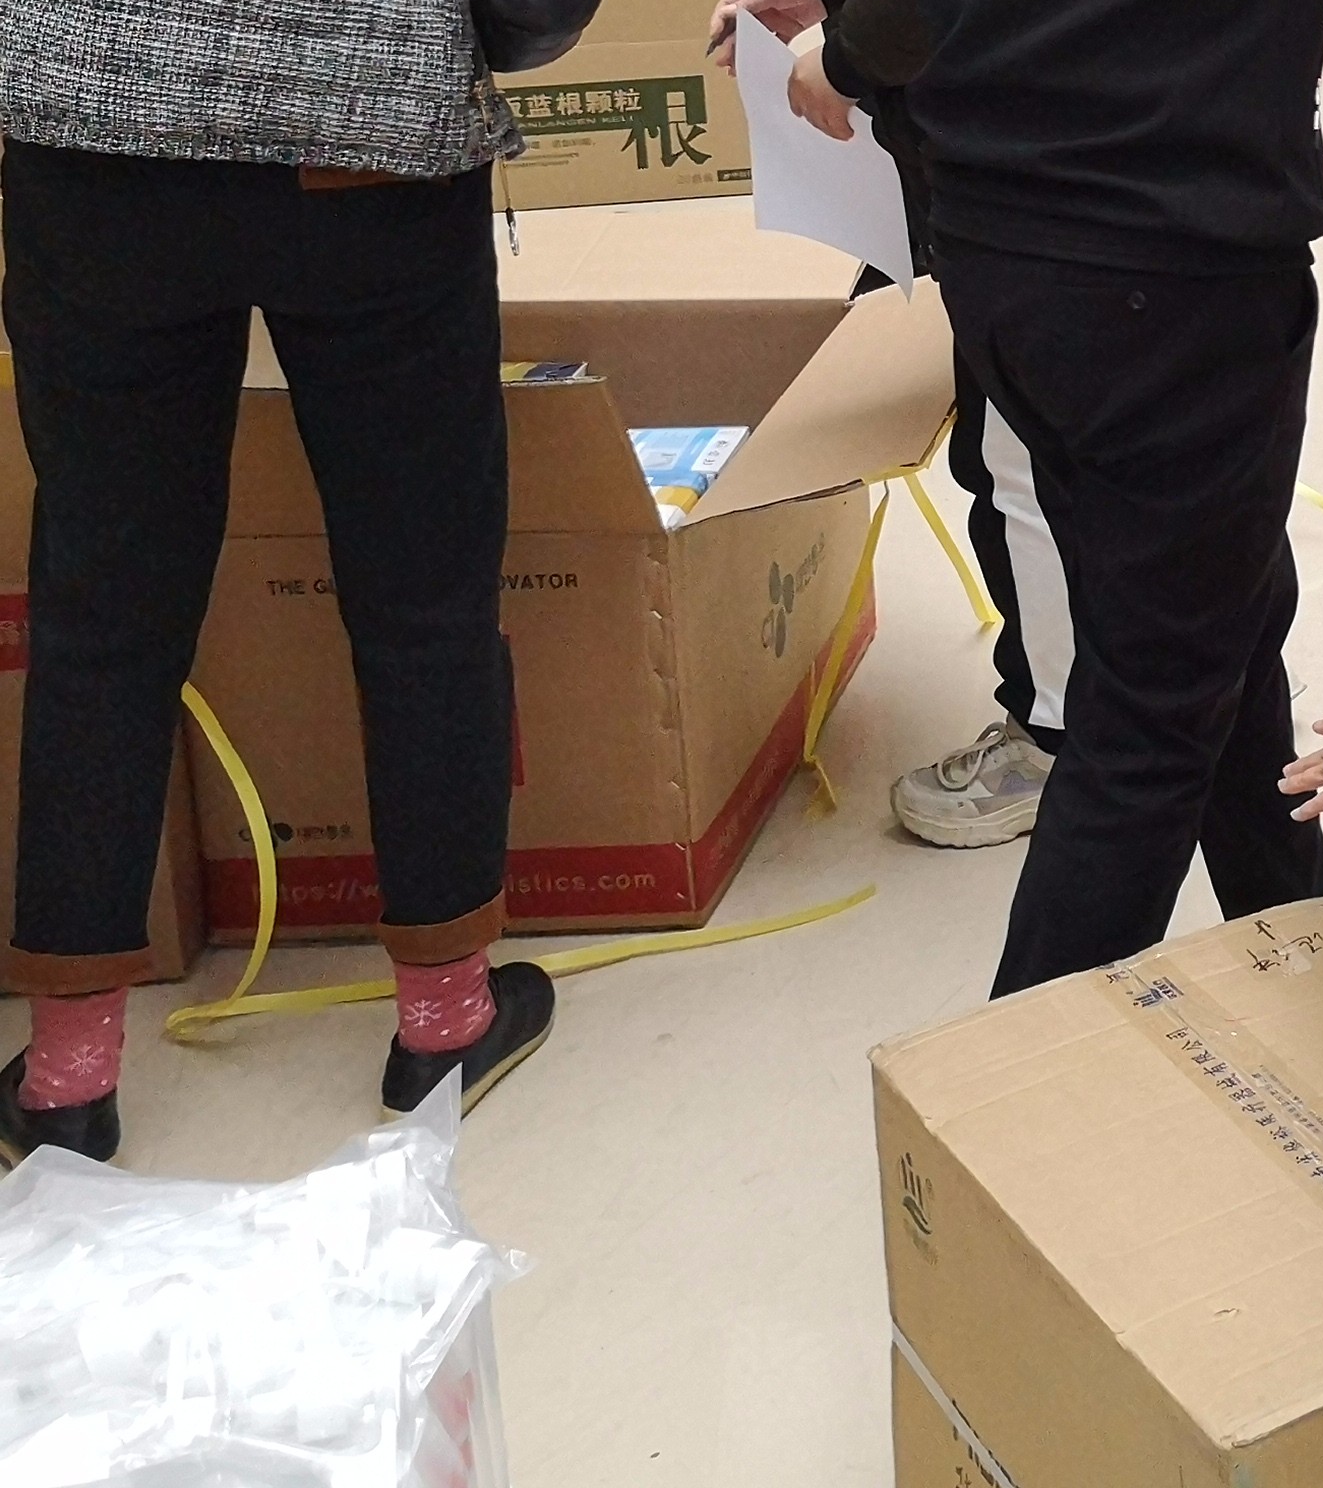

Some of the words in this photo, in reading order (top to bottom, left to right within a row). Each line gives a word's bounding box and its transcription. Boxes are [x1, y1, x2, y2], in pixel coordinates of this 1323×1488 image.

[517, 117, 596, 128] ANLANGEN
[267, 579, 305, 596] THE
[507, 870, 657, 894] istics.com
